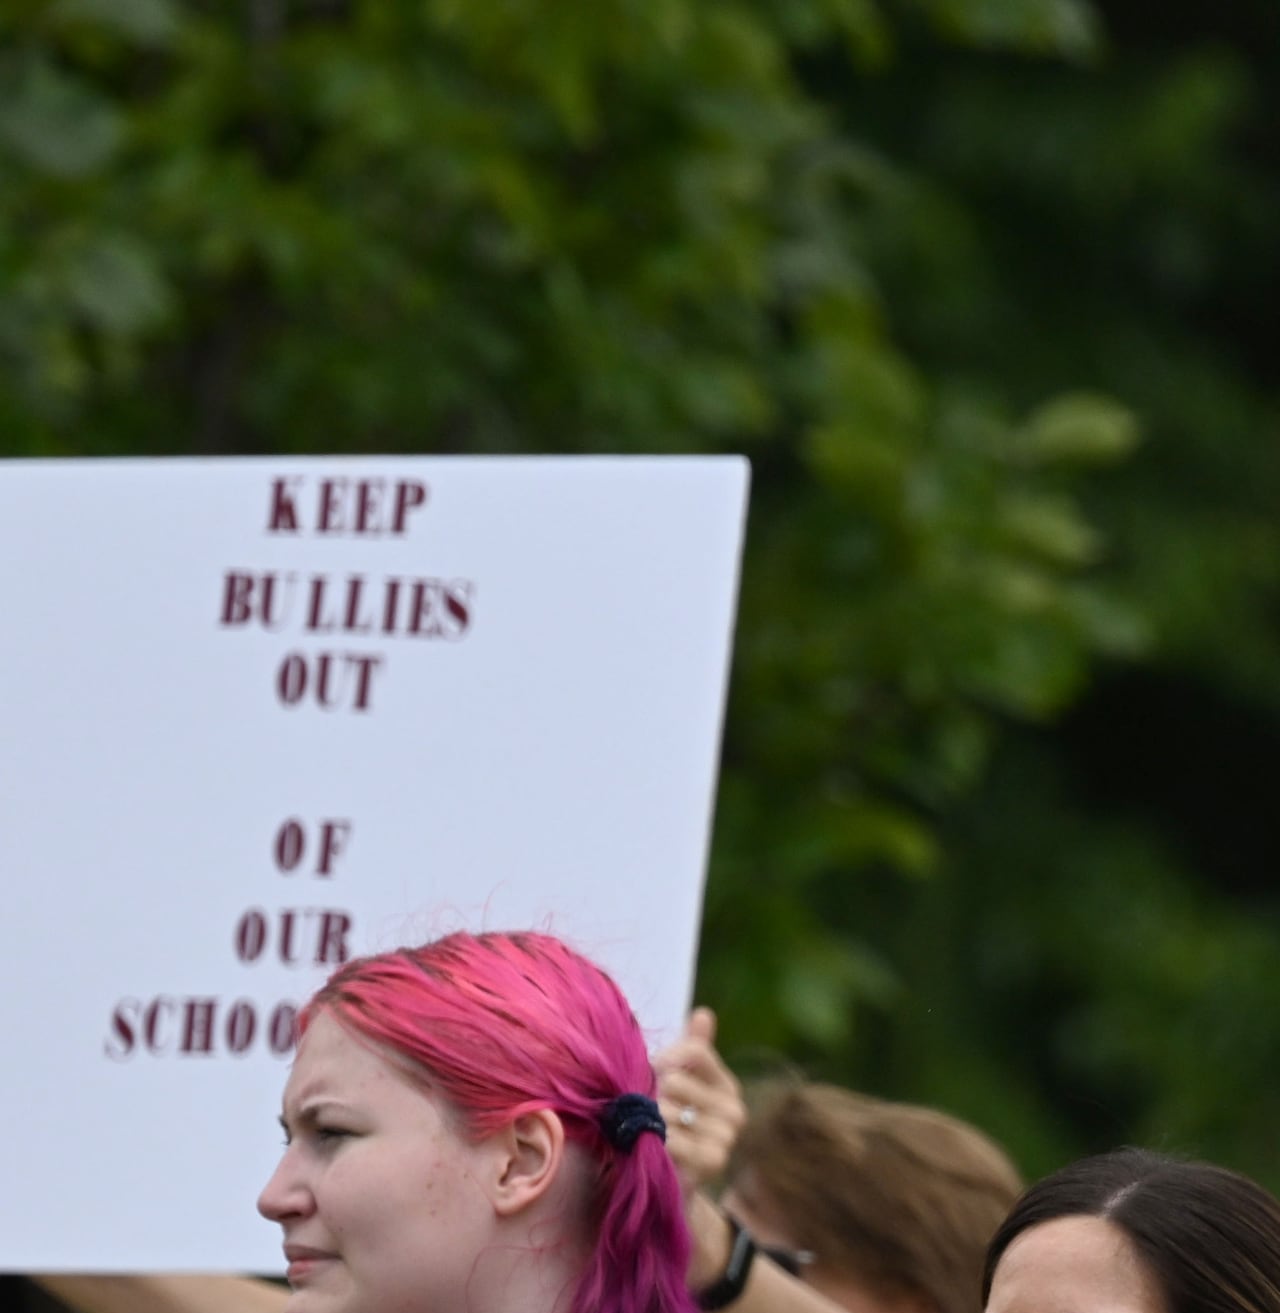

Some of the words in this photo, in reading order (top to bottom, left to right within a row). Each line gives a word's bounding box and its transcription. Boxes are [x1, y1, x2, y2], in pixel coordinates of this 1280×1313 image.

[266, 477, 428, 535] KEEP
[218, 569, 474, 638] BULLIES
[274, 651, 382, 712] OUT
[272, 817, 350, 877] OF
[233, 908, 354, 966] OUR
[103, 994, 299, 1062] SCHOO
